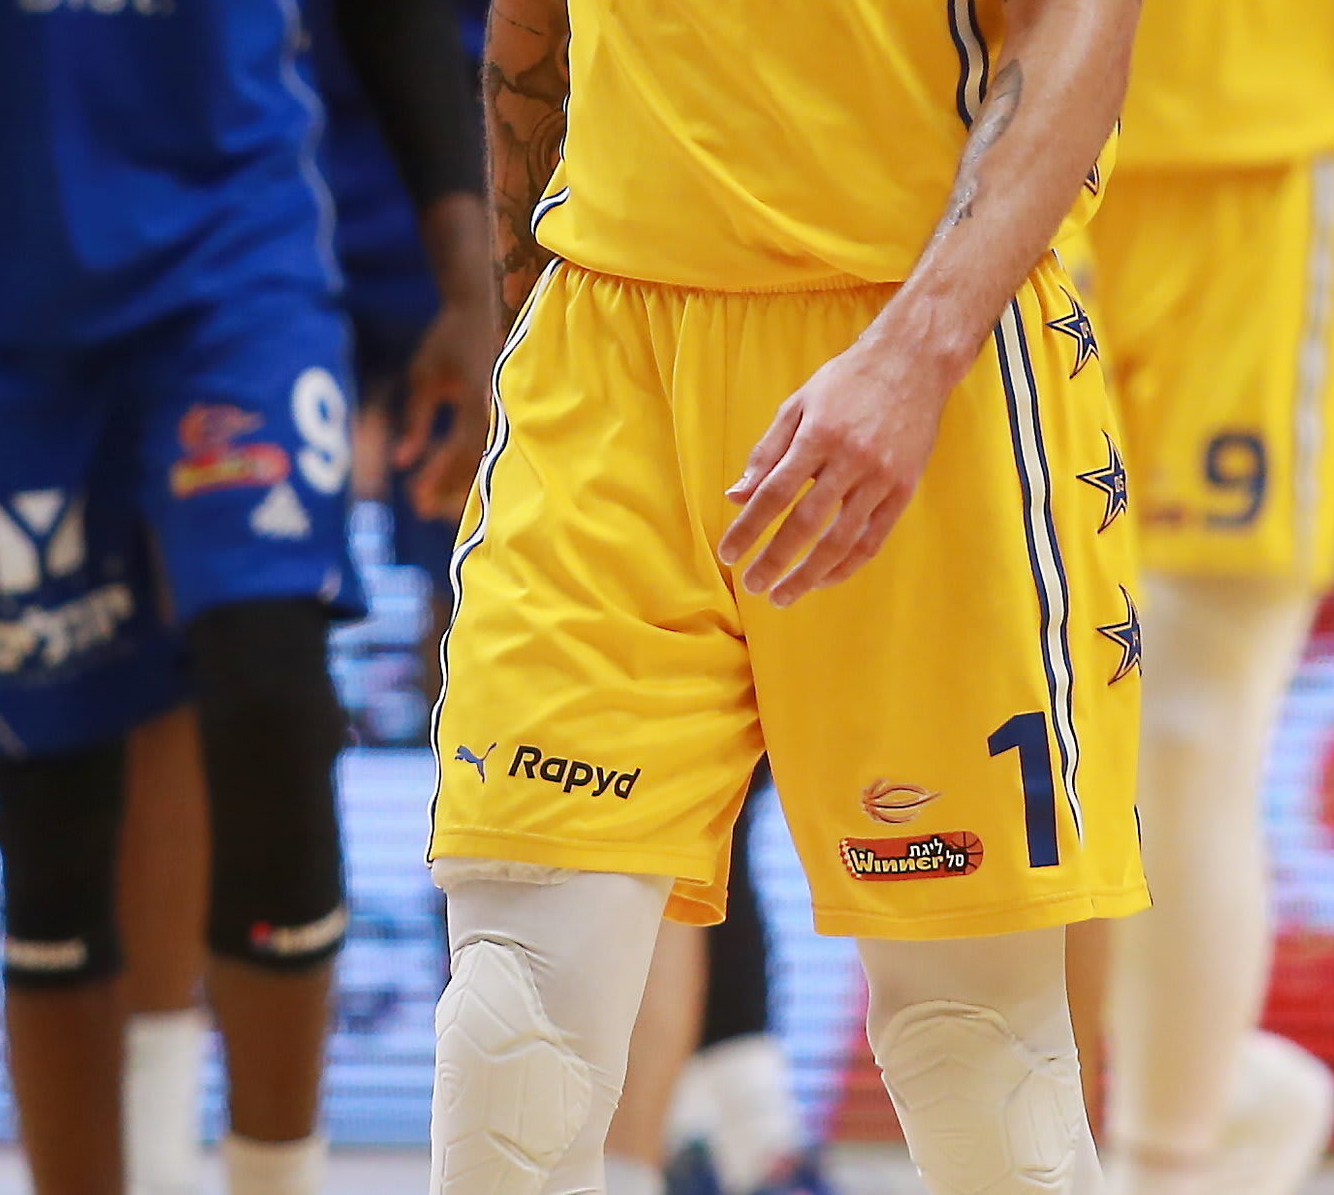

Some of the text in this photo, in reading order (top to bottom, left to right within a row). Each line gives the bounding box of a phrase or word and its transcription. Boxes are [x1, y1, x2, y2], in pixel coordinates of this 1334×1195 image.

[291, 367, 350, 495] 9
[1204, 430, 1268, 531] 9
[508, 745, 642, 800] Rapyd
[987, 711, 1060, 869] 1
[850, 850, 965, 873] Winner סל
[909, 838, 943, 857] ליגת
